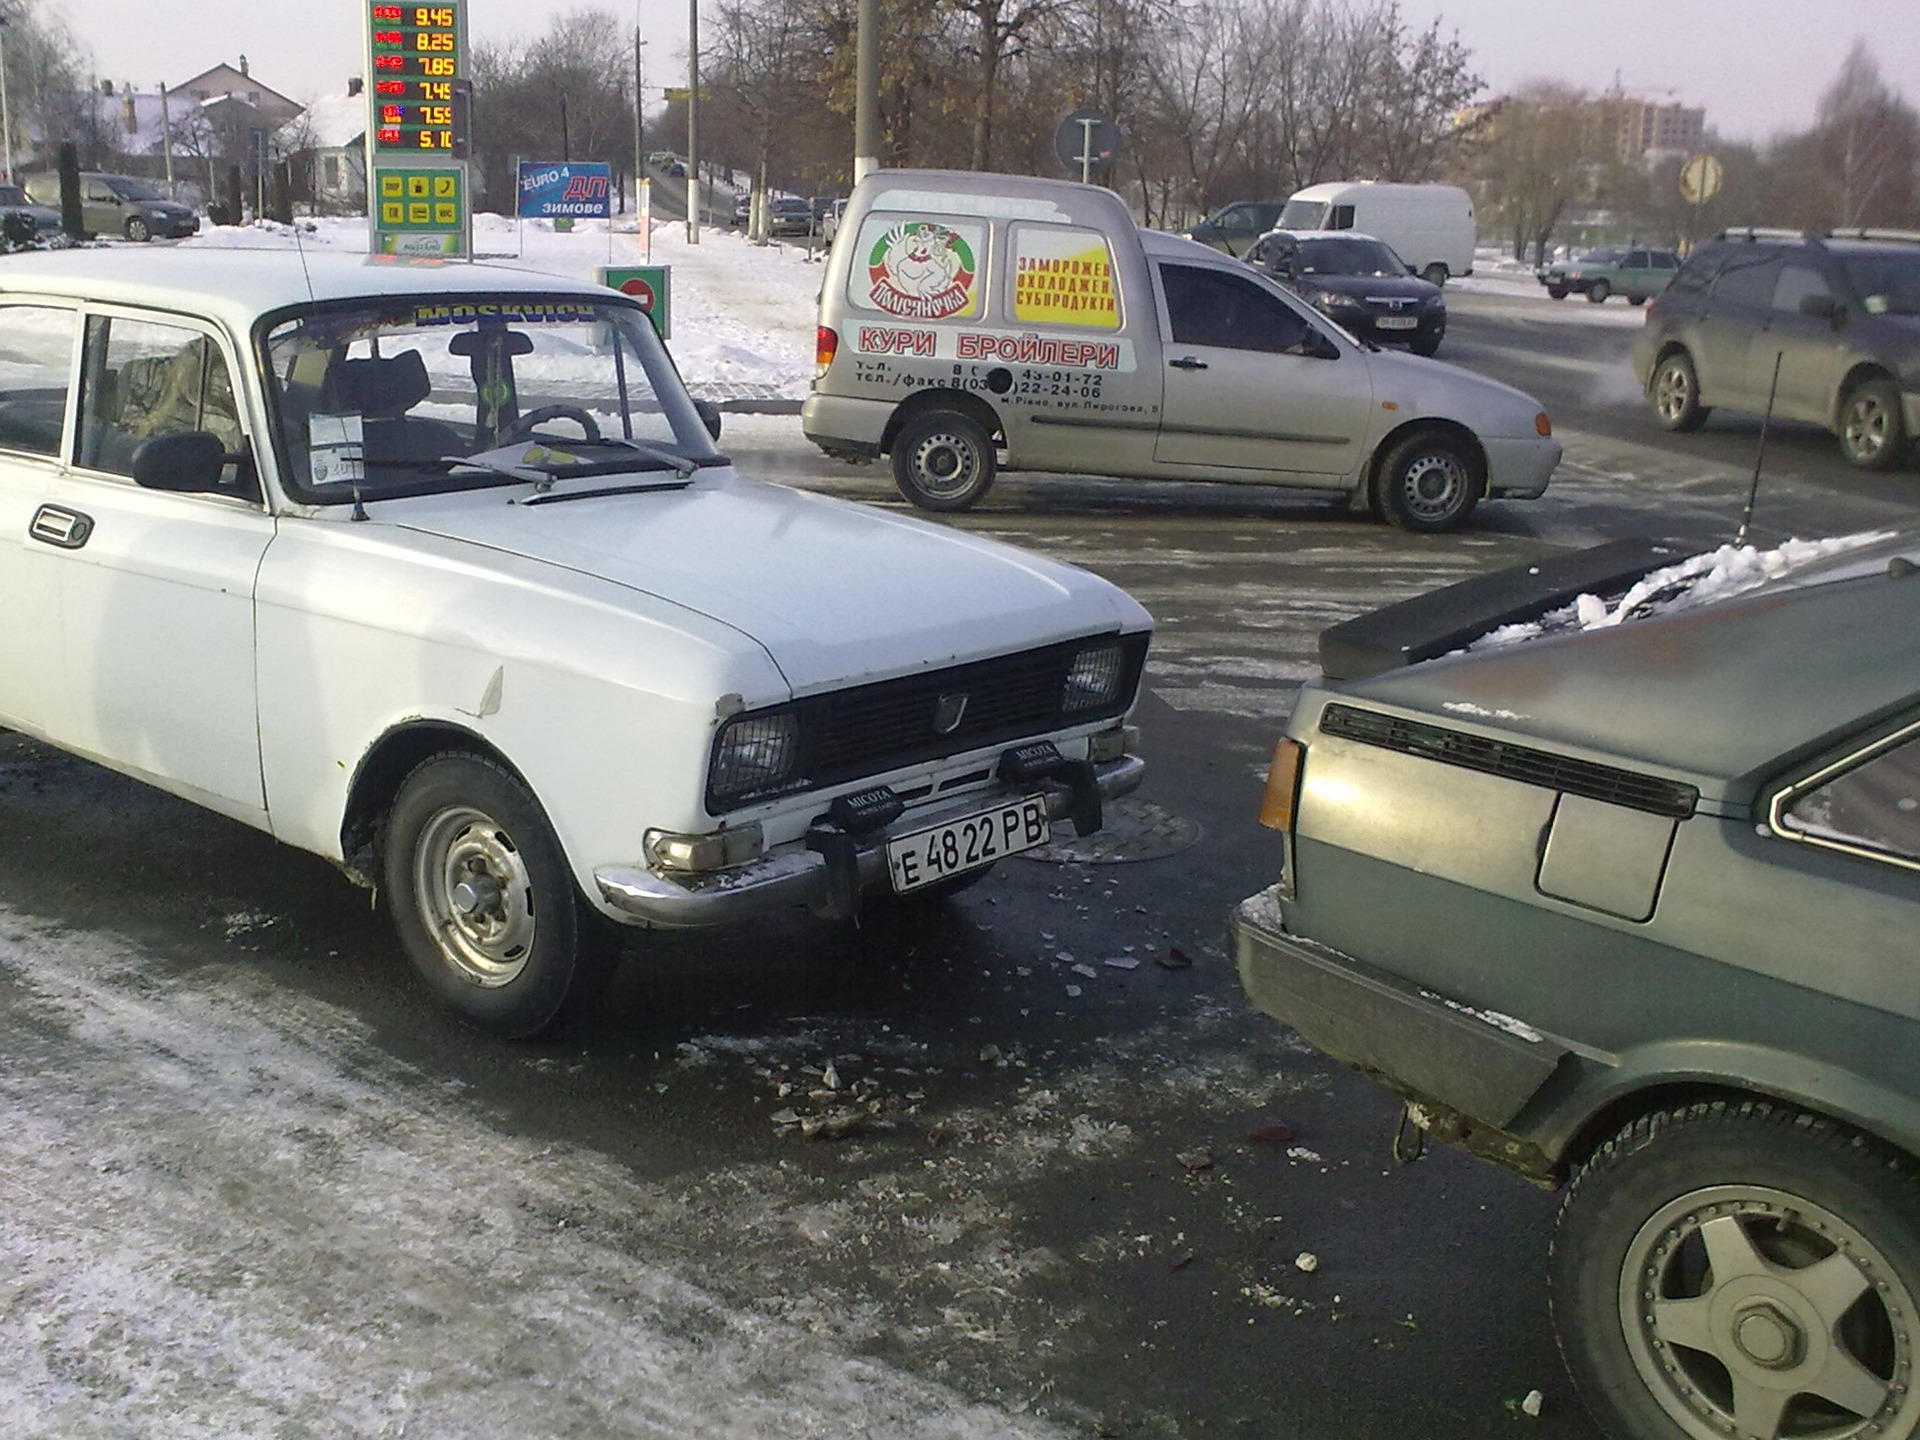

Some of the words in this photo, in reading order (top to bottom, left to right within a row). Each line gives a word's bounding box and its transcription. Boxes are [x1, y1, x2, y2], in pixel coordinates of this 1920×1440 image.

[416, 8, 453, 26] 9.45
[416, 33, 454, 51] 8.25
[418, 57, 455, 76] 7.85
[523, 170, 560, 190] EURO
[563, 175, 607, 201] ДП
[416, 304, 597, 328] MOSKVICH
[858, 326, 937, 357] КУРИ
[956, 332, 1119, 370] БРОЙЛЕРИ
[927, 817, 996, 873] 4822
